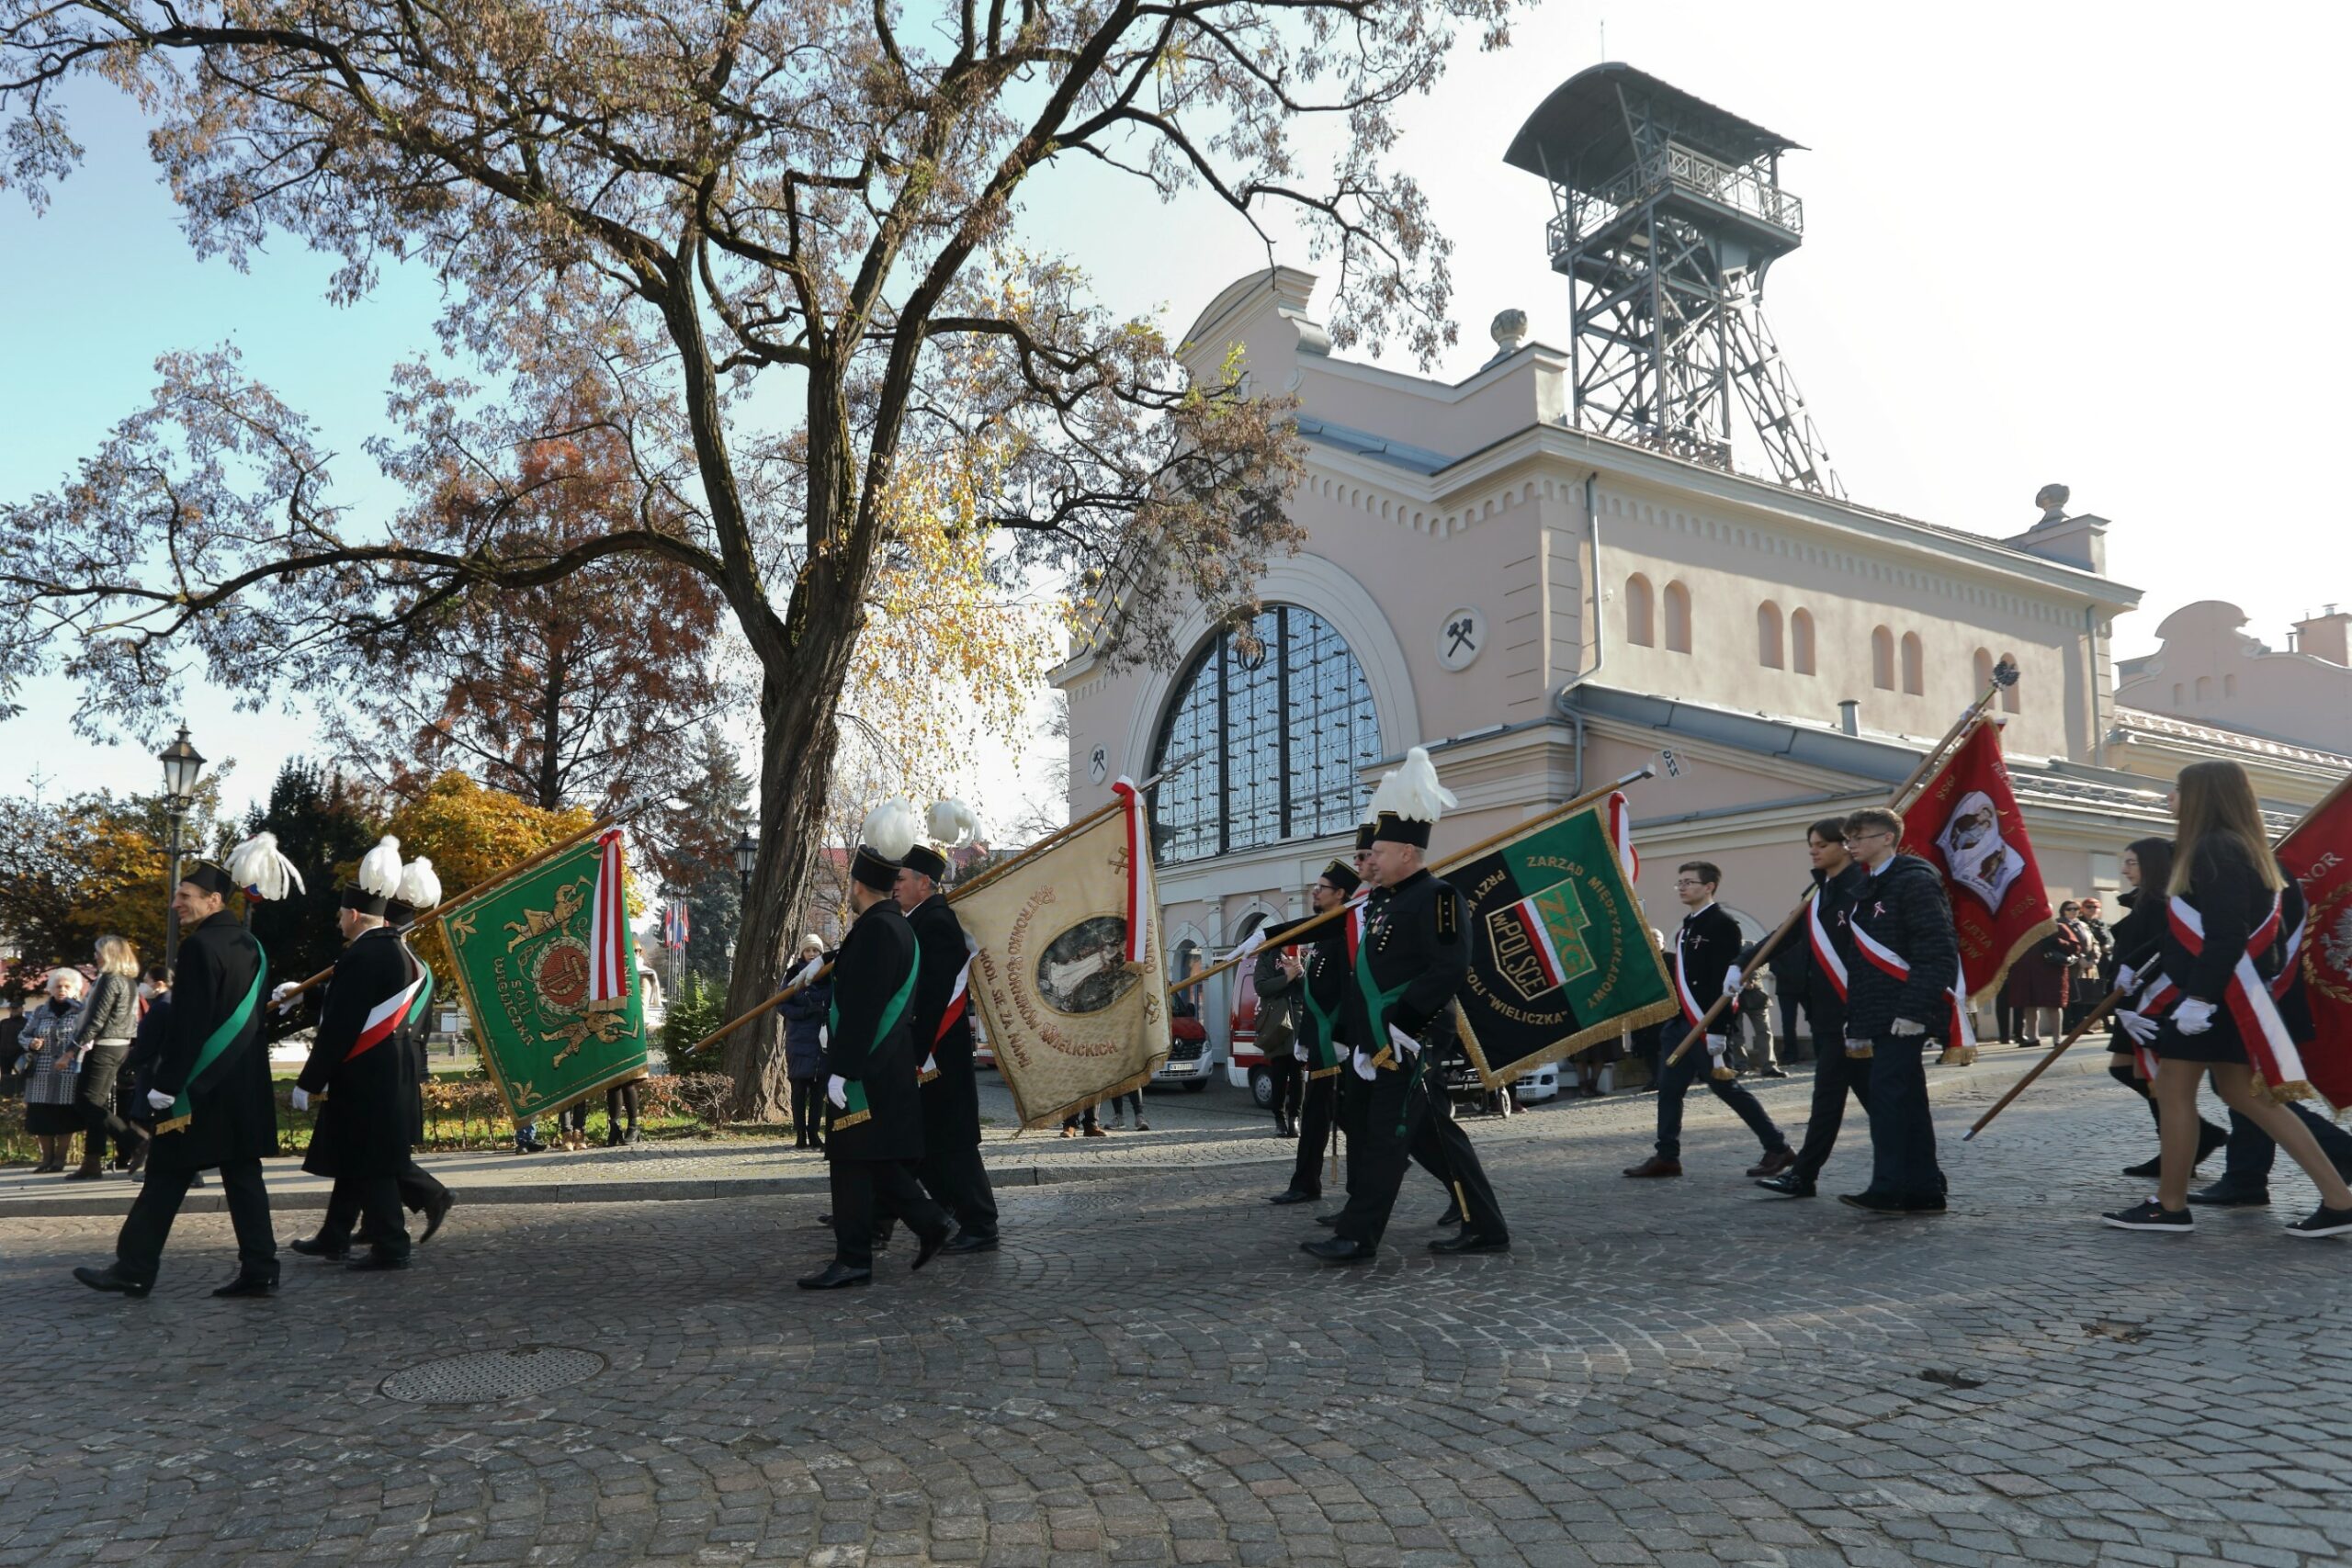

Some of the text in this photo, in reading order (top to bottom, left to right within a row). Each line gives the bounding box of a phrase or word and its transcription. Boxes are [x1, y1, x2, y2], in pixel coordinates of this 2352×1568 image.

[1474, 869, 1507, 900] PRZY
[1527, 856, 1584, 876] ZARZĄD
[2296, 852, 2345, 890] NOR
[1008, 885, 1056, 955] PATRONKO
[1039, 1022, 1118, 1057] WIELICKICH
[493, 956, 535, 1046] WIELICZKA
[511, 979, 531, 1016] SOLI
[1487, 993, 1568, 1026] "WIELICZKA"
[1000, 1010, 1014, 1031] ZA
[1008, 1031, 1033, 1068] NAMI
